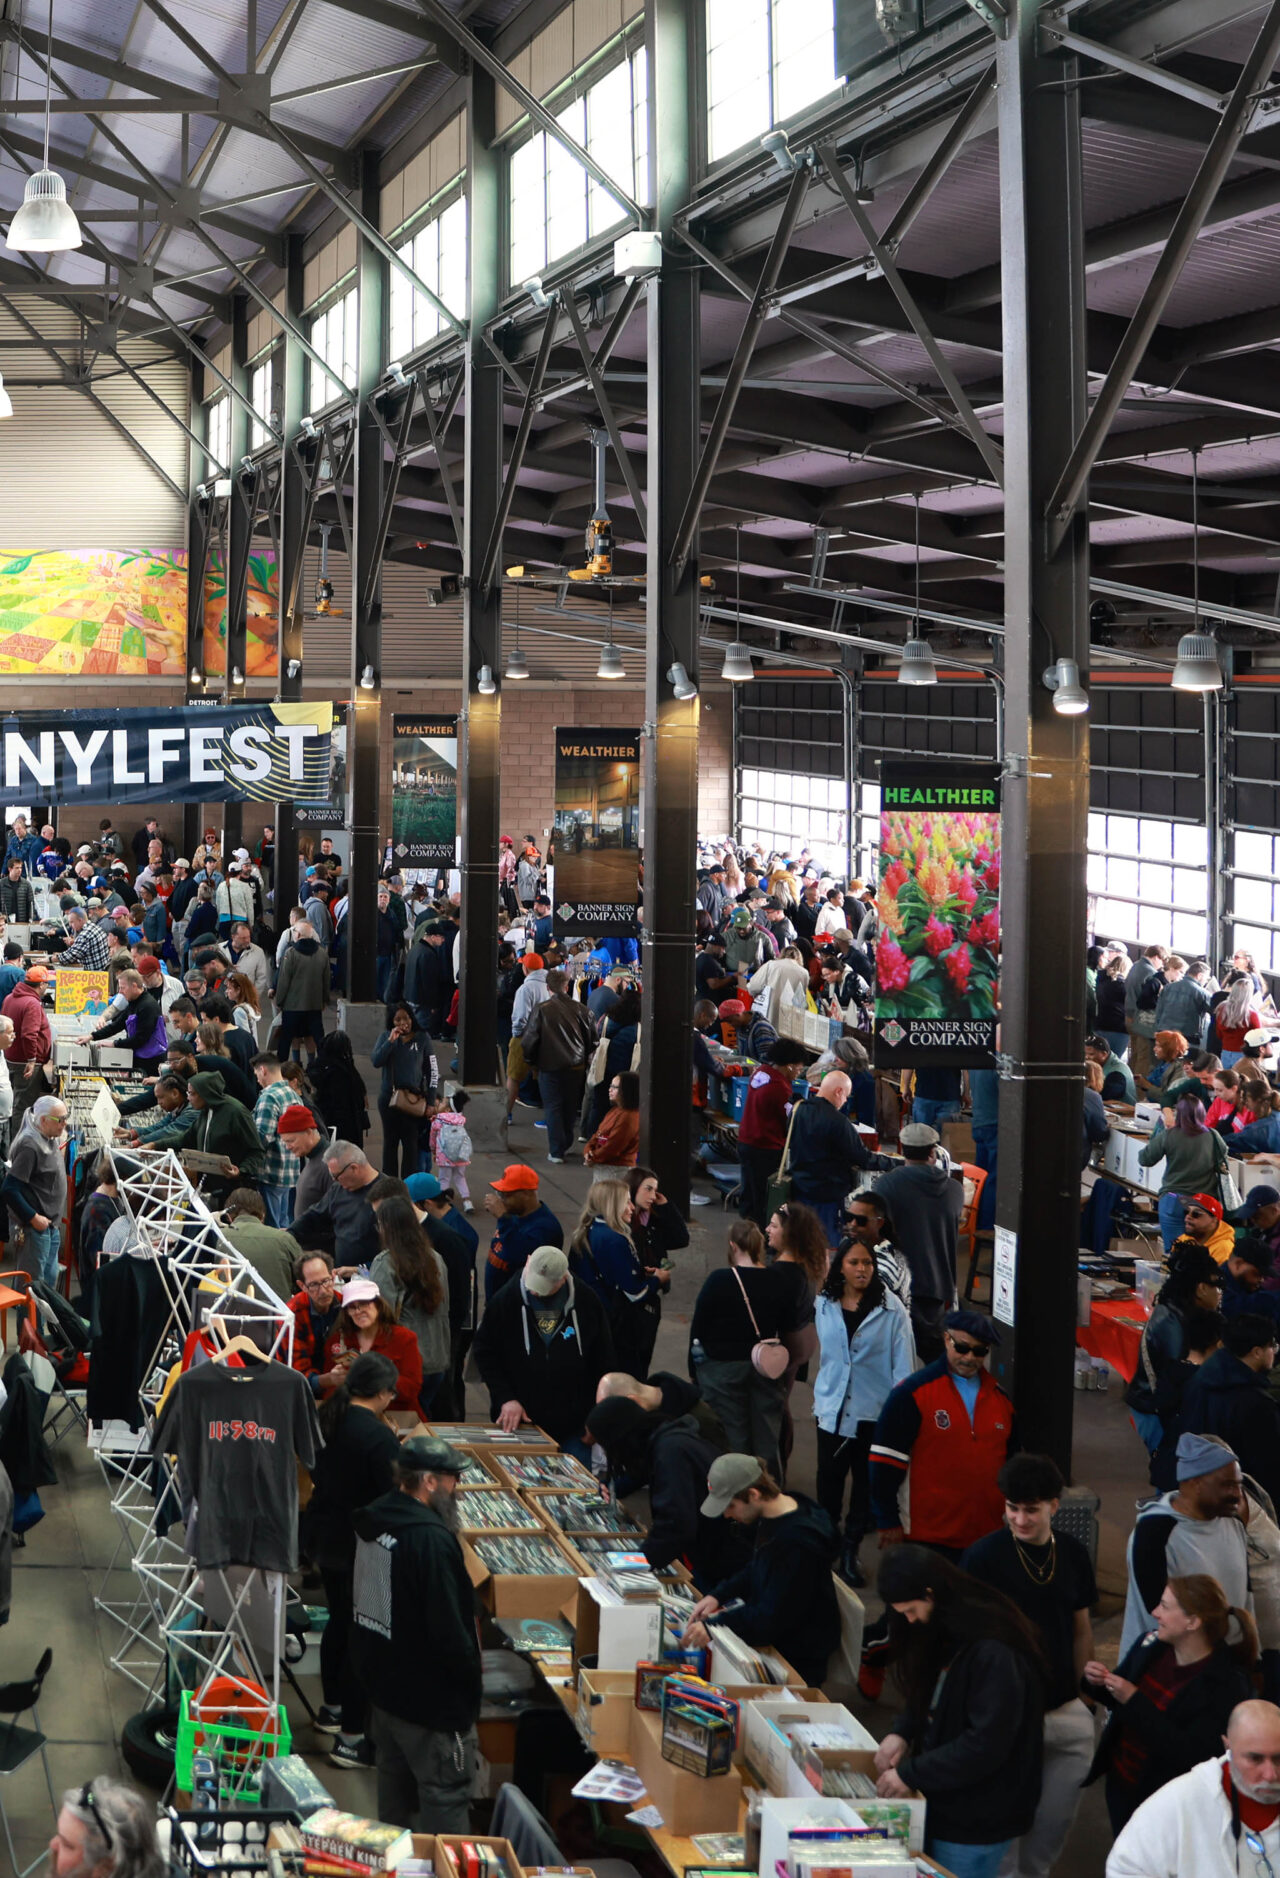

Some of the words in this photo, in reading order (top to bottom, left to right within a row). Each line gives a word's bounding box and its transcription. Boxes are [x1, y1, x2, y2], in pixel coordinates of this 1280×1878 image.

[396, 725, 454, 735] WEALTHIER
[560, 745, 636, 758] WEALTHIER
[885, 787, 997, 805] HEALTHIER
[578, 904, 613, 912] BANNER
[614, 904, 635, 912] SIGN
[577, 911, 634, 921] COMPANY
[59, 972, 108, 987] RECORDS
[910, 1021, 961, 1032] BANNER
[963, 1022, 992, 1032] SIGN
[909, 1032, 991, 1046] COMPANY
[300, 1833, 355, 1861] STEPHEN
[356, 1851, 386, 1871] KING
